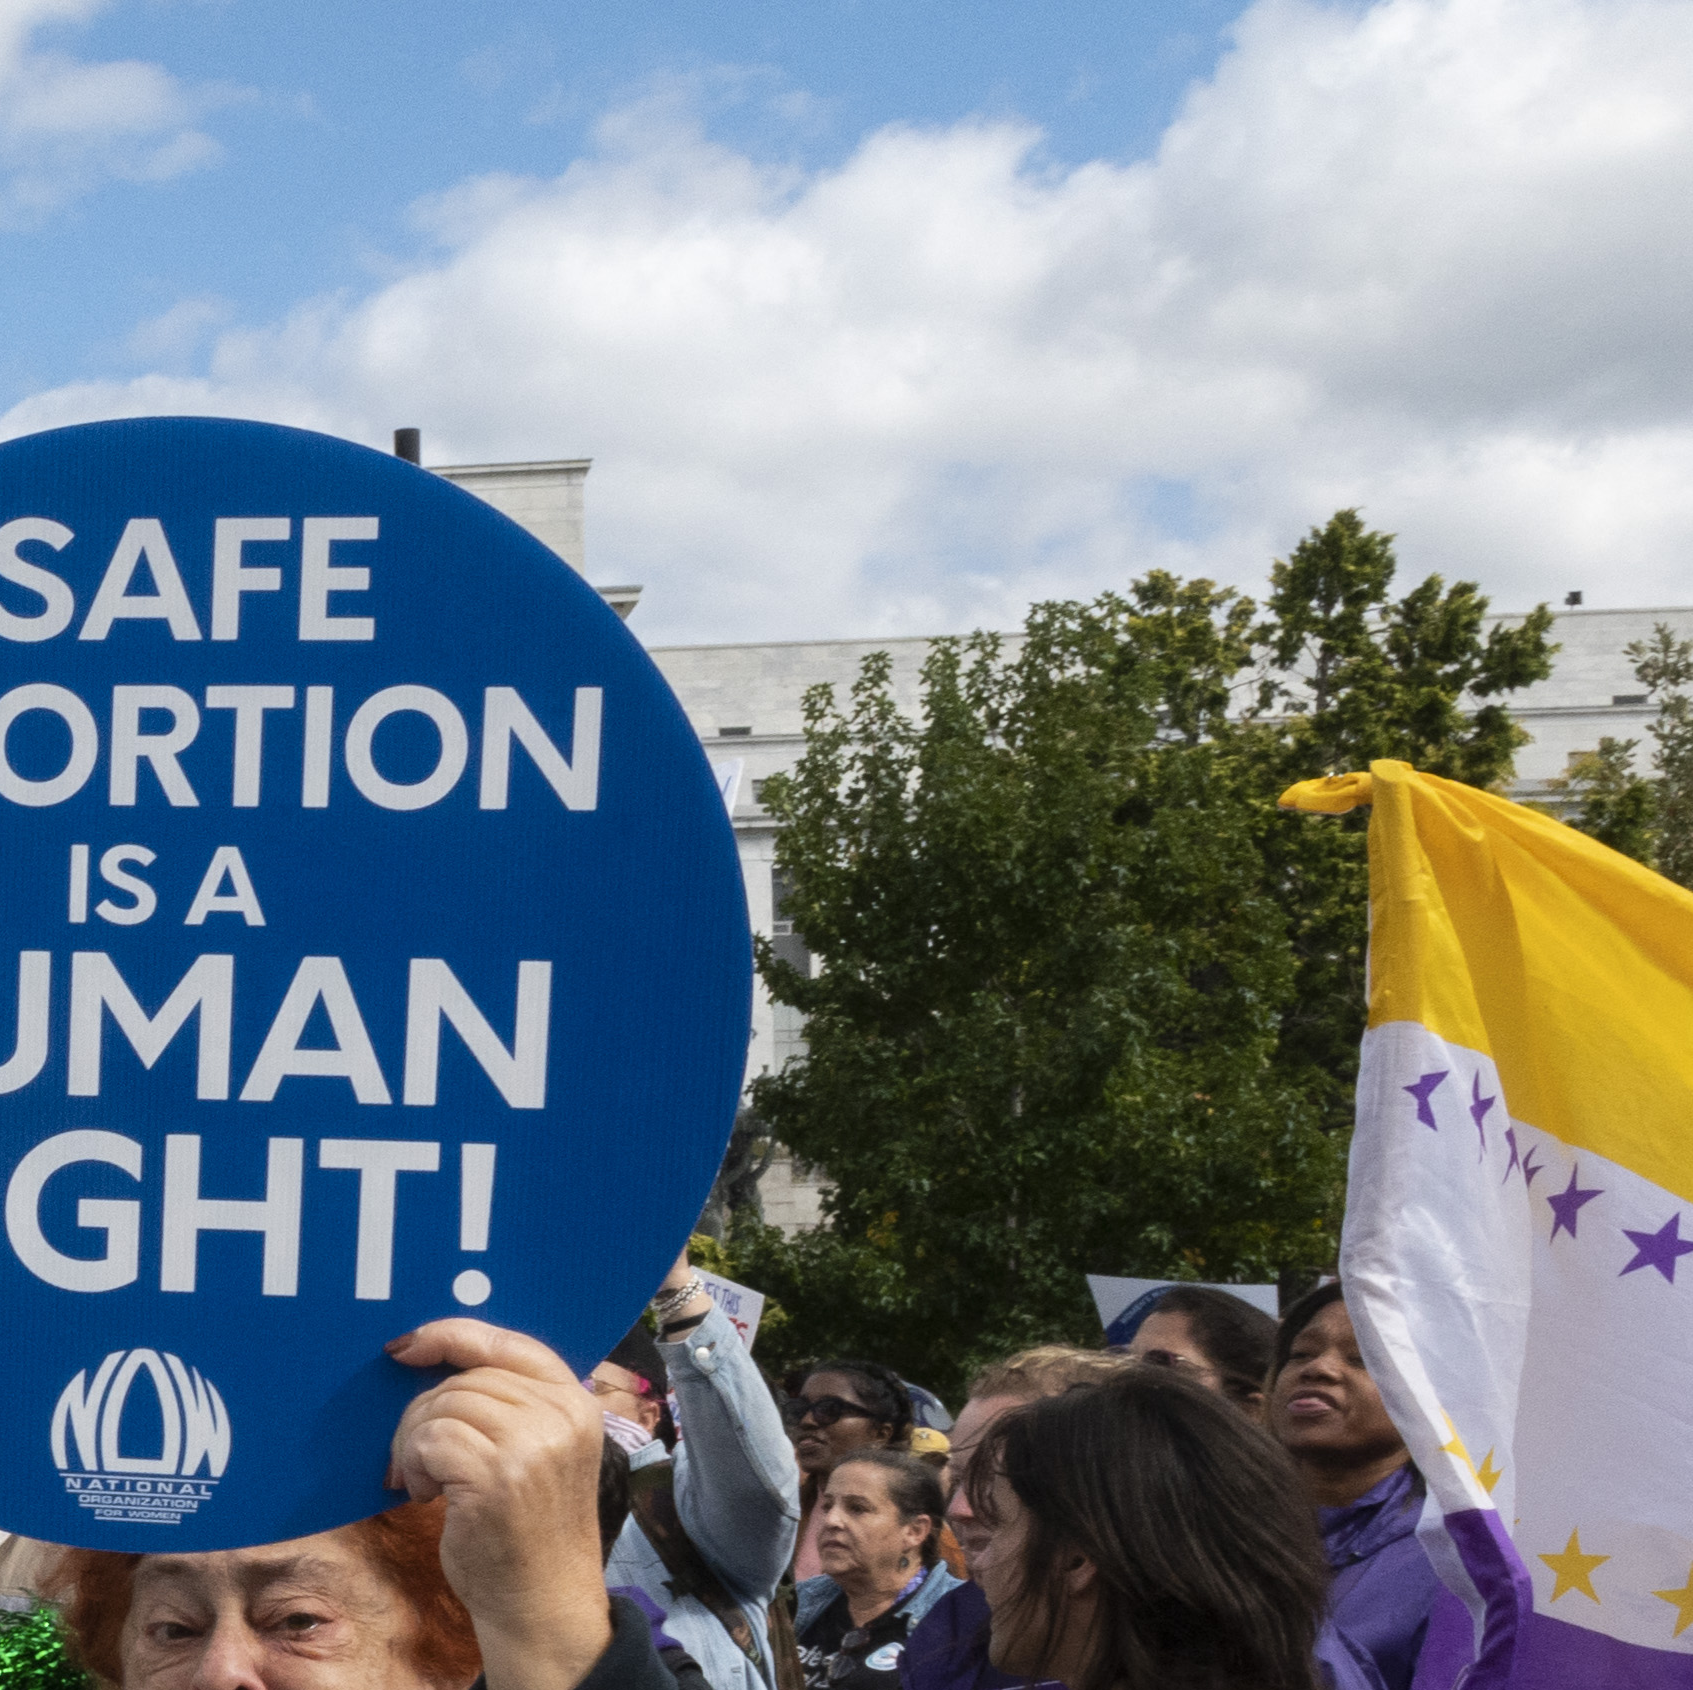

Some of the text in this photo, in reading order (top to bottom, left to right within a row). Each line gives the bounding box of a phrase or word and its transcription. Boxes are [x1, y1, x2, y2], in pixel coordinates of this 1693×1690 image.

[67, 843, 268, 926] IS A
[49, 1347, 232, 1479] NOW
[65, 1476, 214, 1498] NATIONAL
[77, 1492, 200, 1510] ORGANIZATION
[94, 1507, 181, 1522] FOR WOMEN
